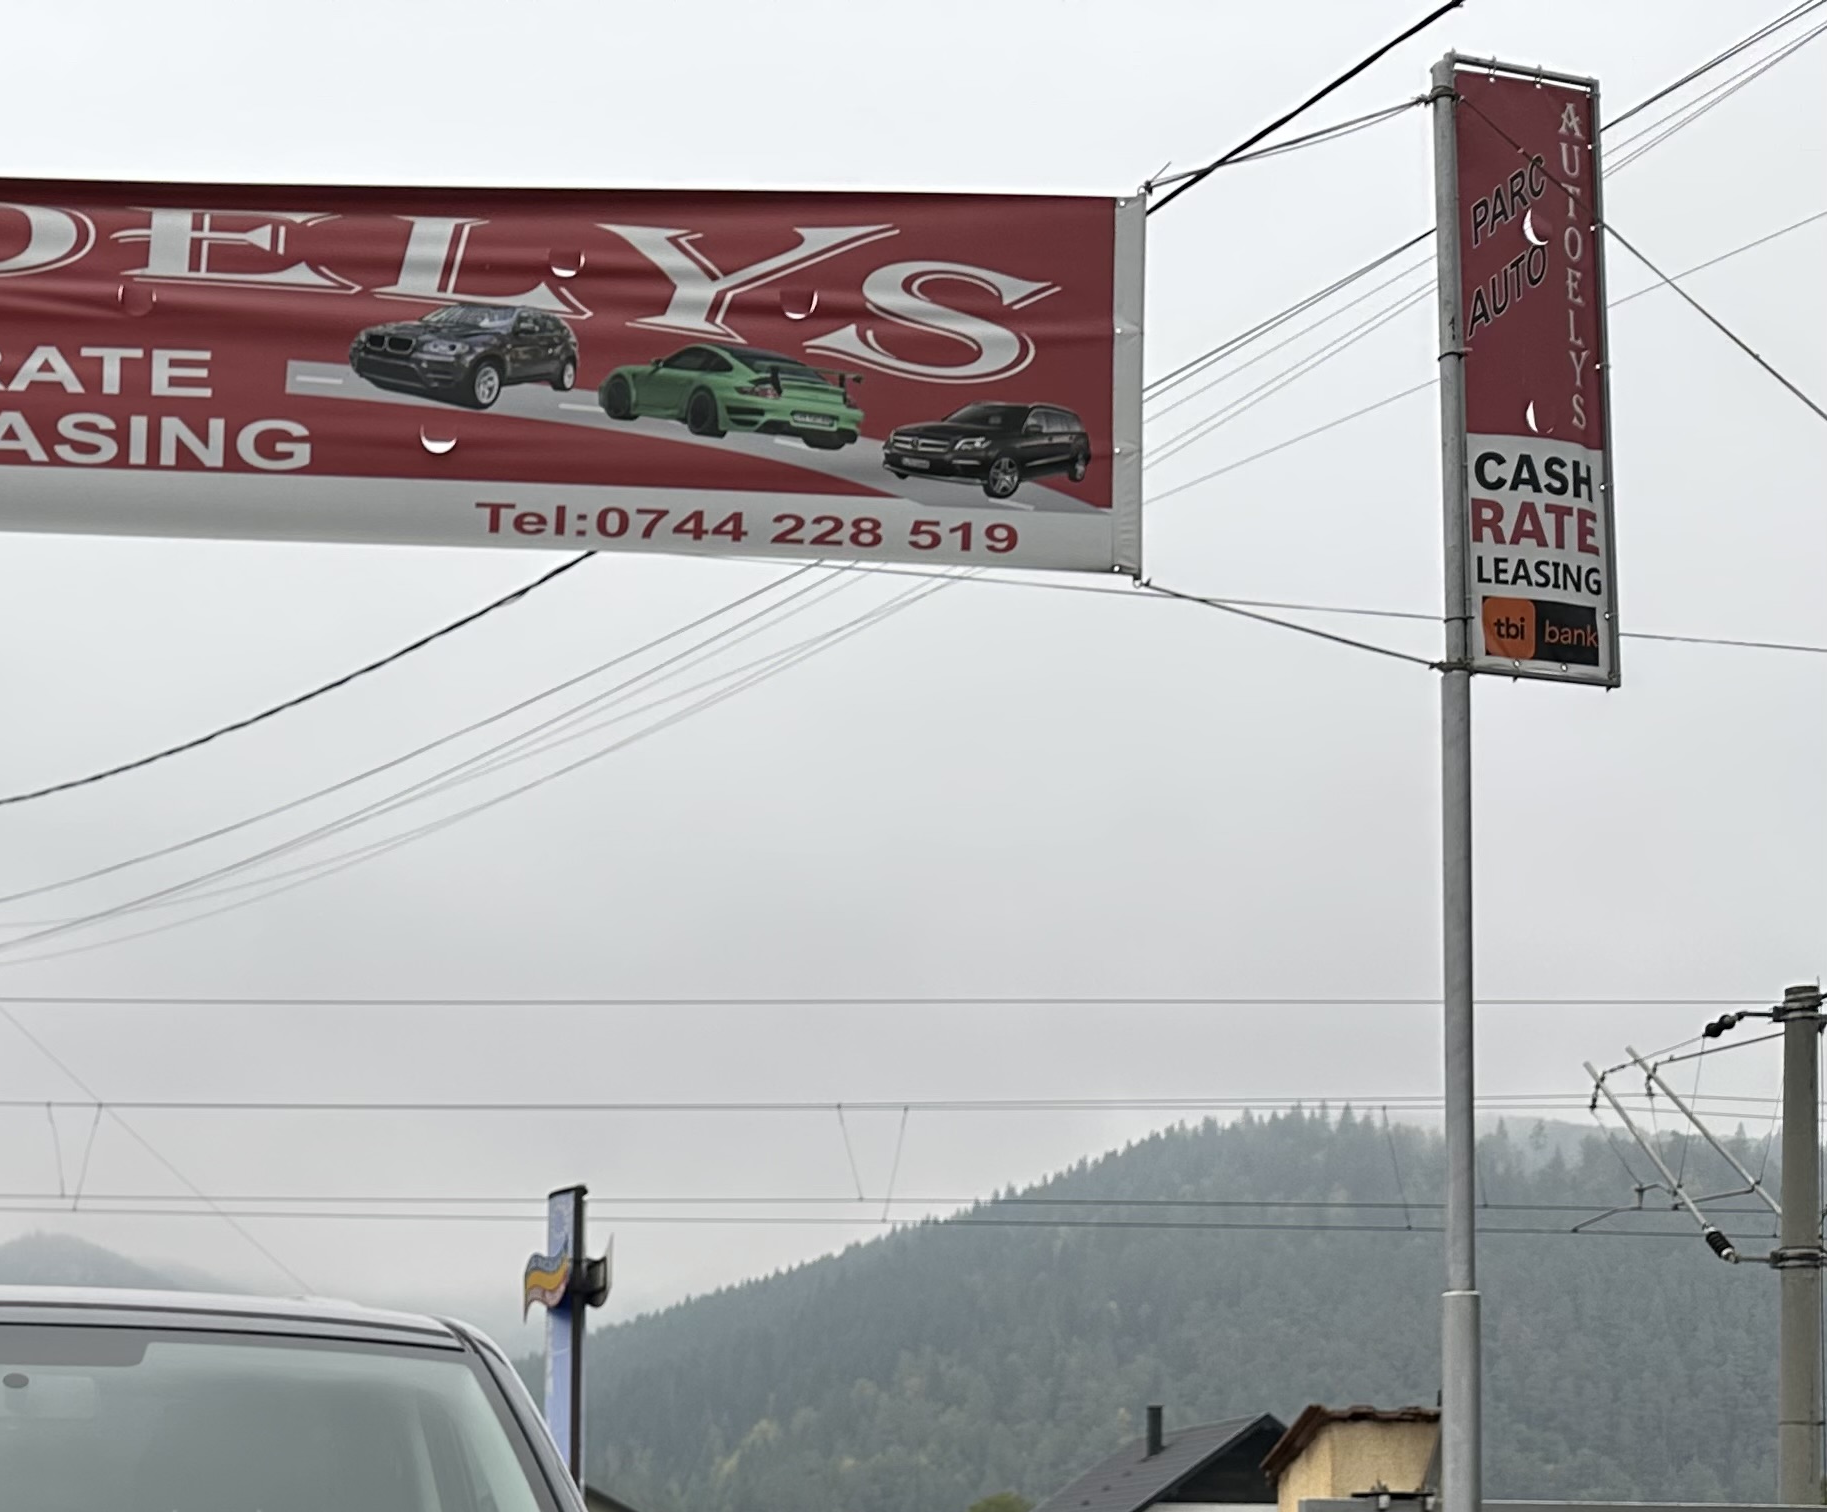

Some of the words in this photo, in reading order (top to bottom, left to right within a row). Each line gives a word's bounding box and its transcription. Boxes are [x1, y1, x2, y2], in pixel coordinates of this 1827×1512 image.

[1471, 153, 1547, 246] PARC
[1468, 242, 1549, 339] AUTO
[1558, 103, 1588, 431] AUTOELYS
[1474, 451, 1593, 503] CASH
[475, 502, 748, 543] Tel:0744
[769, 512, 883, 548] 228
[907, 520, 1019, 554] 519
[1472, 498, 1600, 556] RATE
[1477, 556, 1602, 596] LEASING
[1494, 618, 1526, 641] tbi
[1544, 620, 1598, 647] bank
